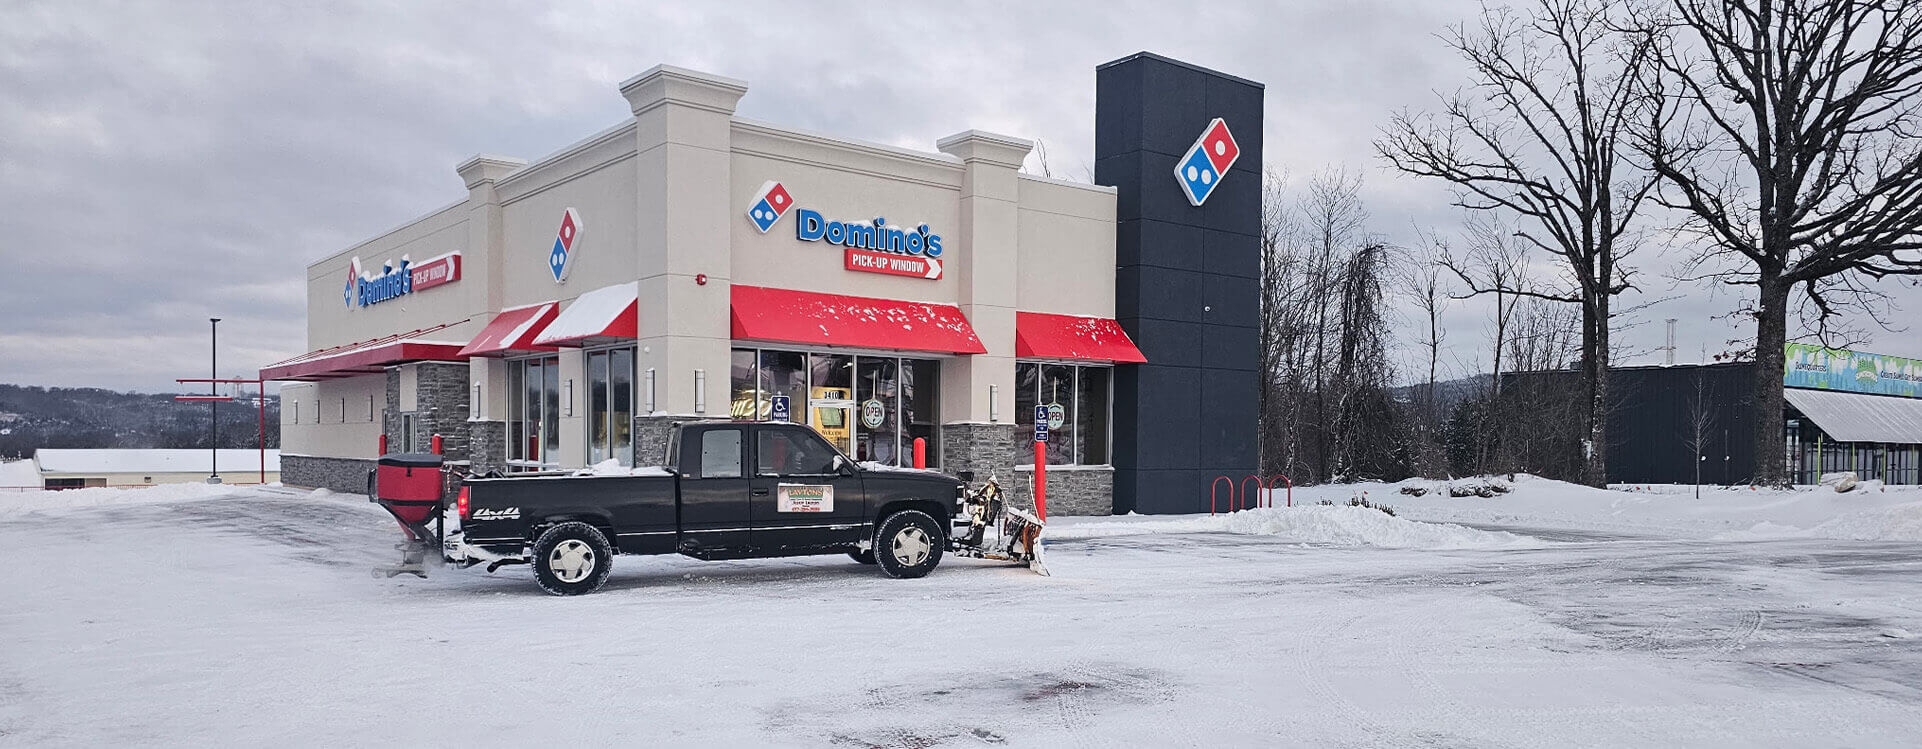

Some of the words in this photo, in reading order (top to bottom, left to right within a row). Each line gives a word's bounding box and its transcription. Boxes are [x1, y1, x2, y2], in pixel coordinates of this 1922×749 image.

[797, 208, 943, 257] Domino's
[852, 254, 888, 269] PICK-UP
[889, 258, 925, 274] WINDOW
[358, 259, 412, 307] Domino's
[413, 270, 429, 286] PICK-UP
[429, 263, 447, 281] WINDOW
[866, 406, 883, 418] OPEN
[1048, 411, 1064, 422] OPEN
[472, 507, 521, 520] 4x4
